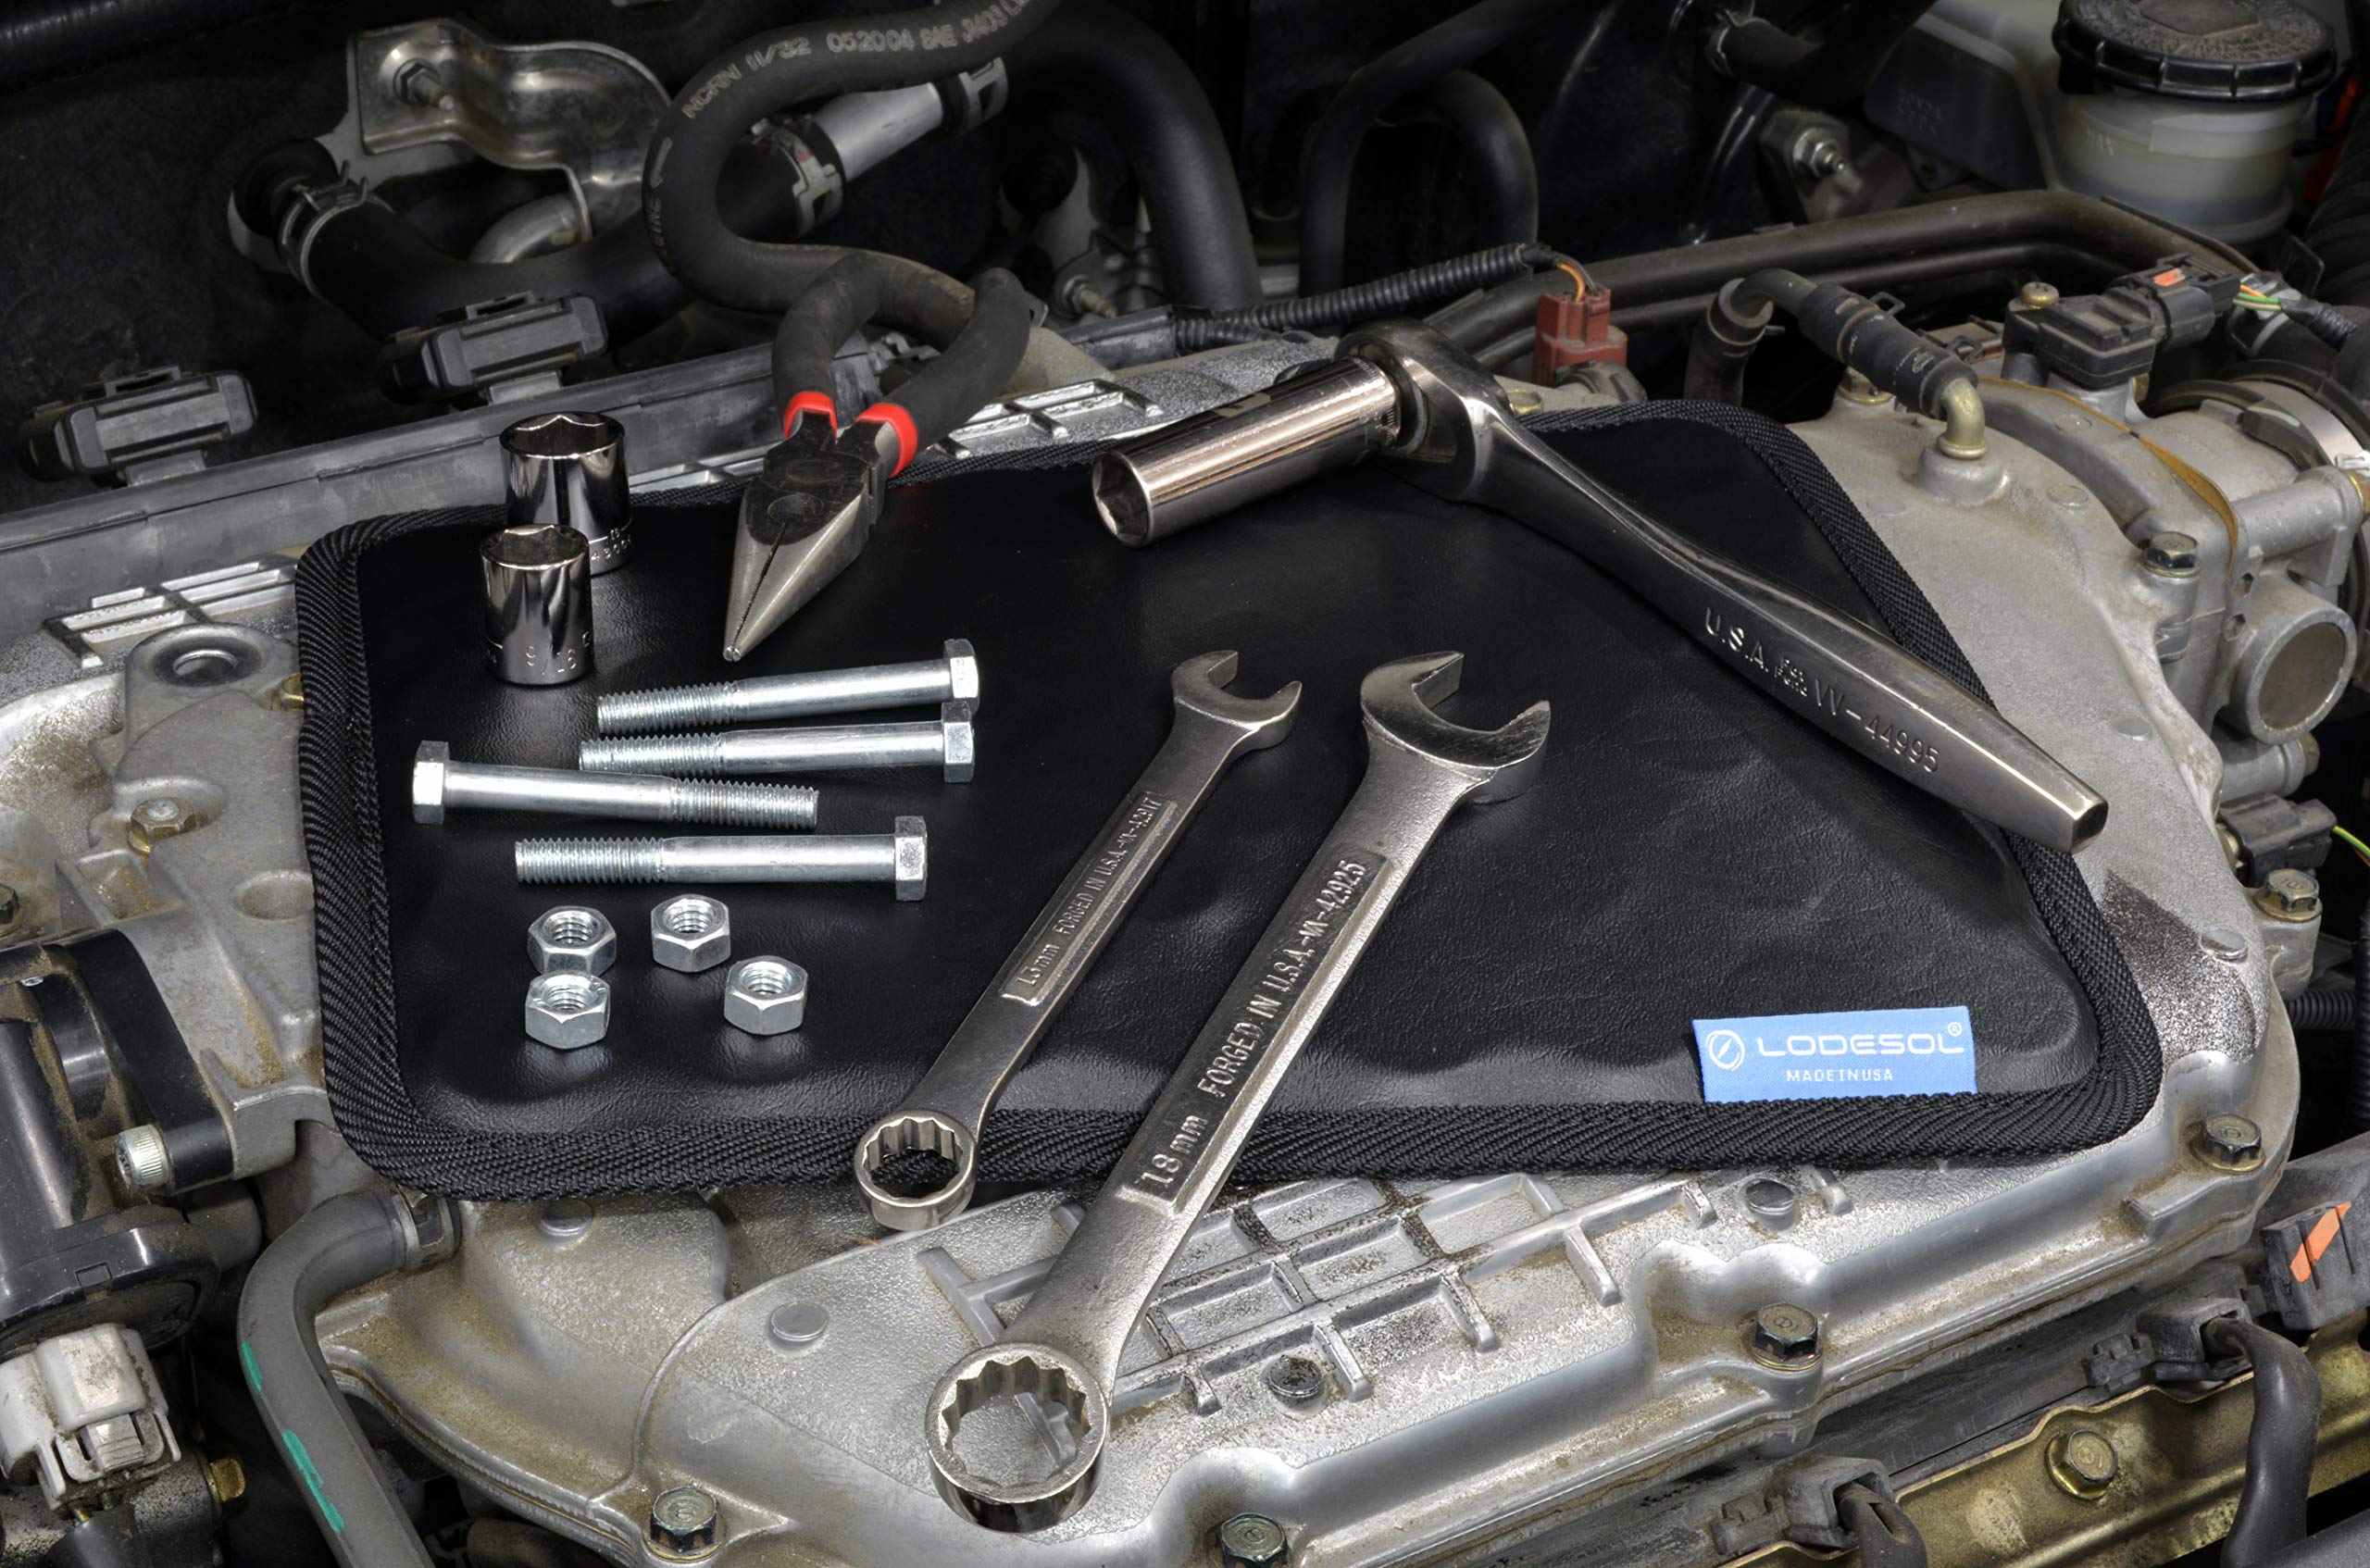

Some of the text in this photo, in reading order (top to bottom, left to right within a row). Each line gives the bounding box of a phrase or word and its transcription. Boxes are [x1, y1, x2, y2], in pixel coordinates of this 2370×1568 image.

[826, 28, 916, 53] 052004
[1705, 607, 1769, 673] U.S.A.
[1053, 892, 1094, 935] FORGED
[1084, 877, 1107, 891] IN
[1197, 1020, 1265, 1099] FORGED
[1246, 992, 1282, 1020] IN
